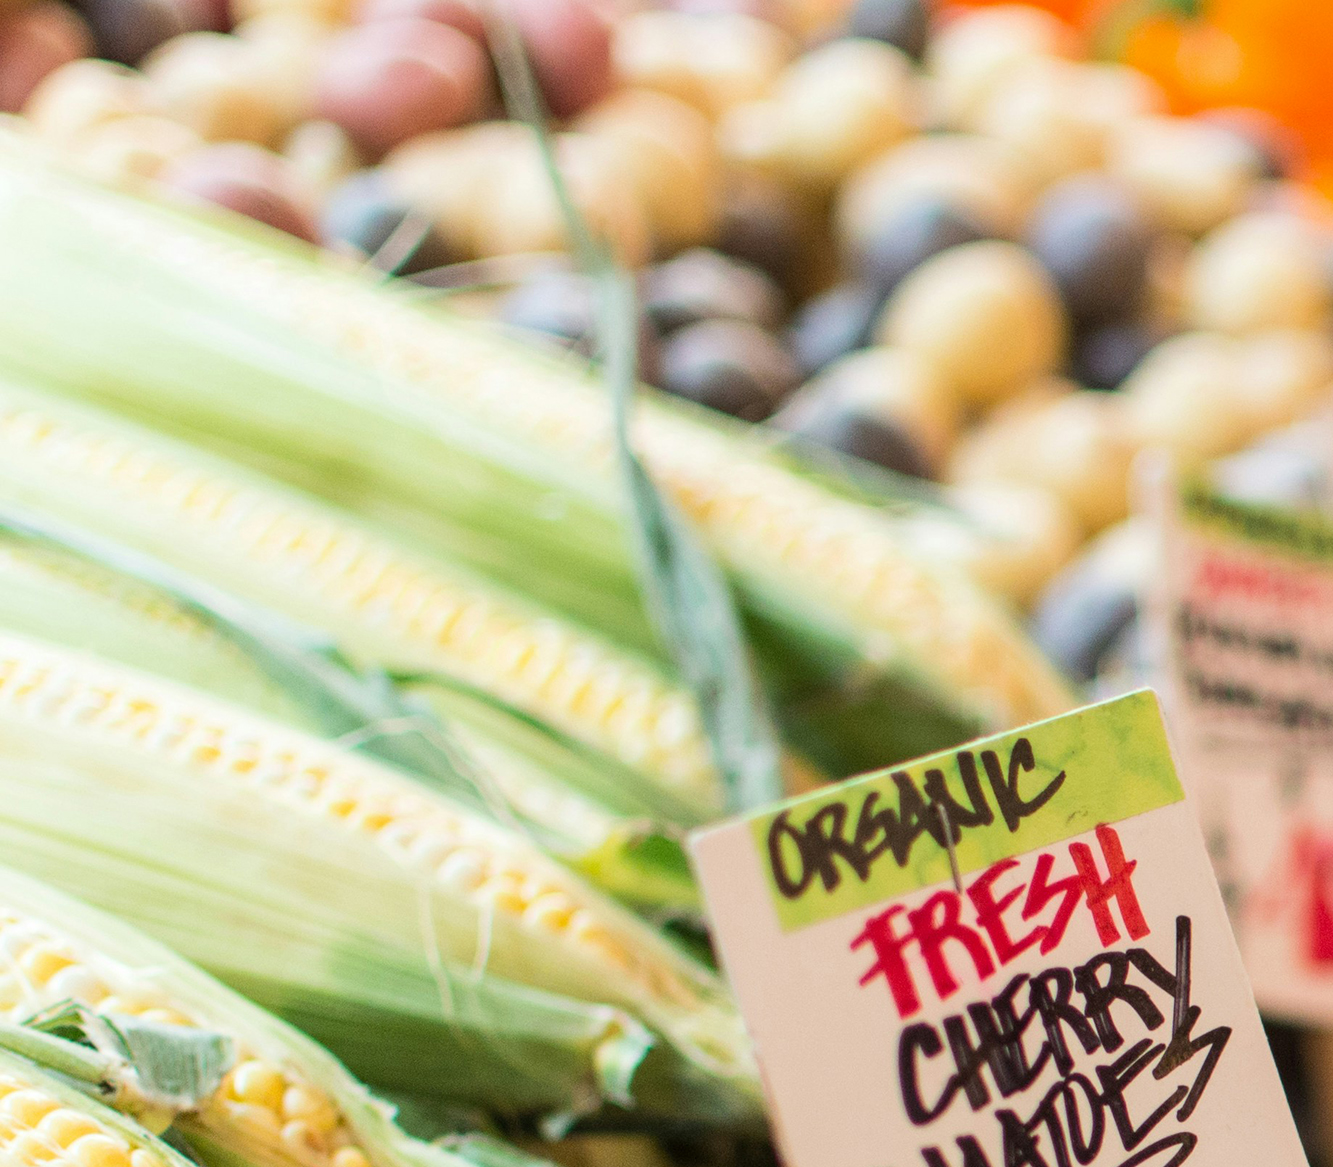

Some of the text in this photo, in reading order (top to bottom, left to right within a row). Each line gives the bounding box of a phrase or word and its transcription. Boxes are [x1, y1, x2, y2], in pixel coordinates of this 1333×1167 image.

[768, 738, 1067, 900] ORGANIC
[849, 823, 1151, 1020] FRESH
[898, 915, 1192, 1127] CHERRY
